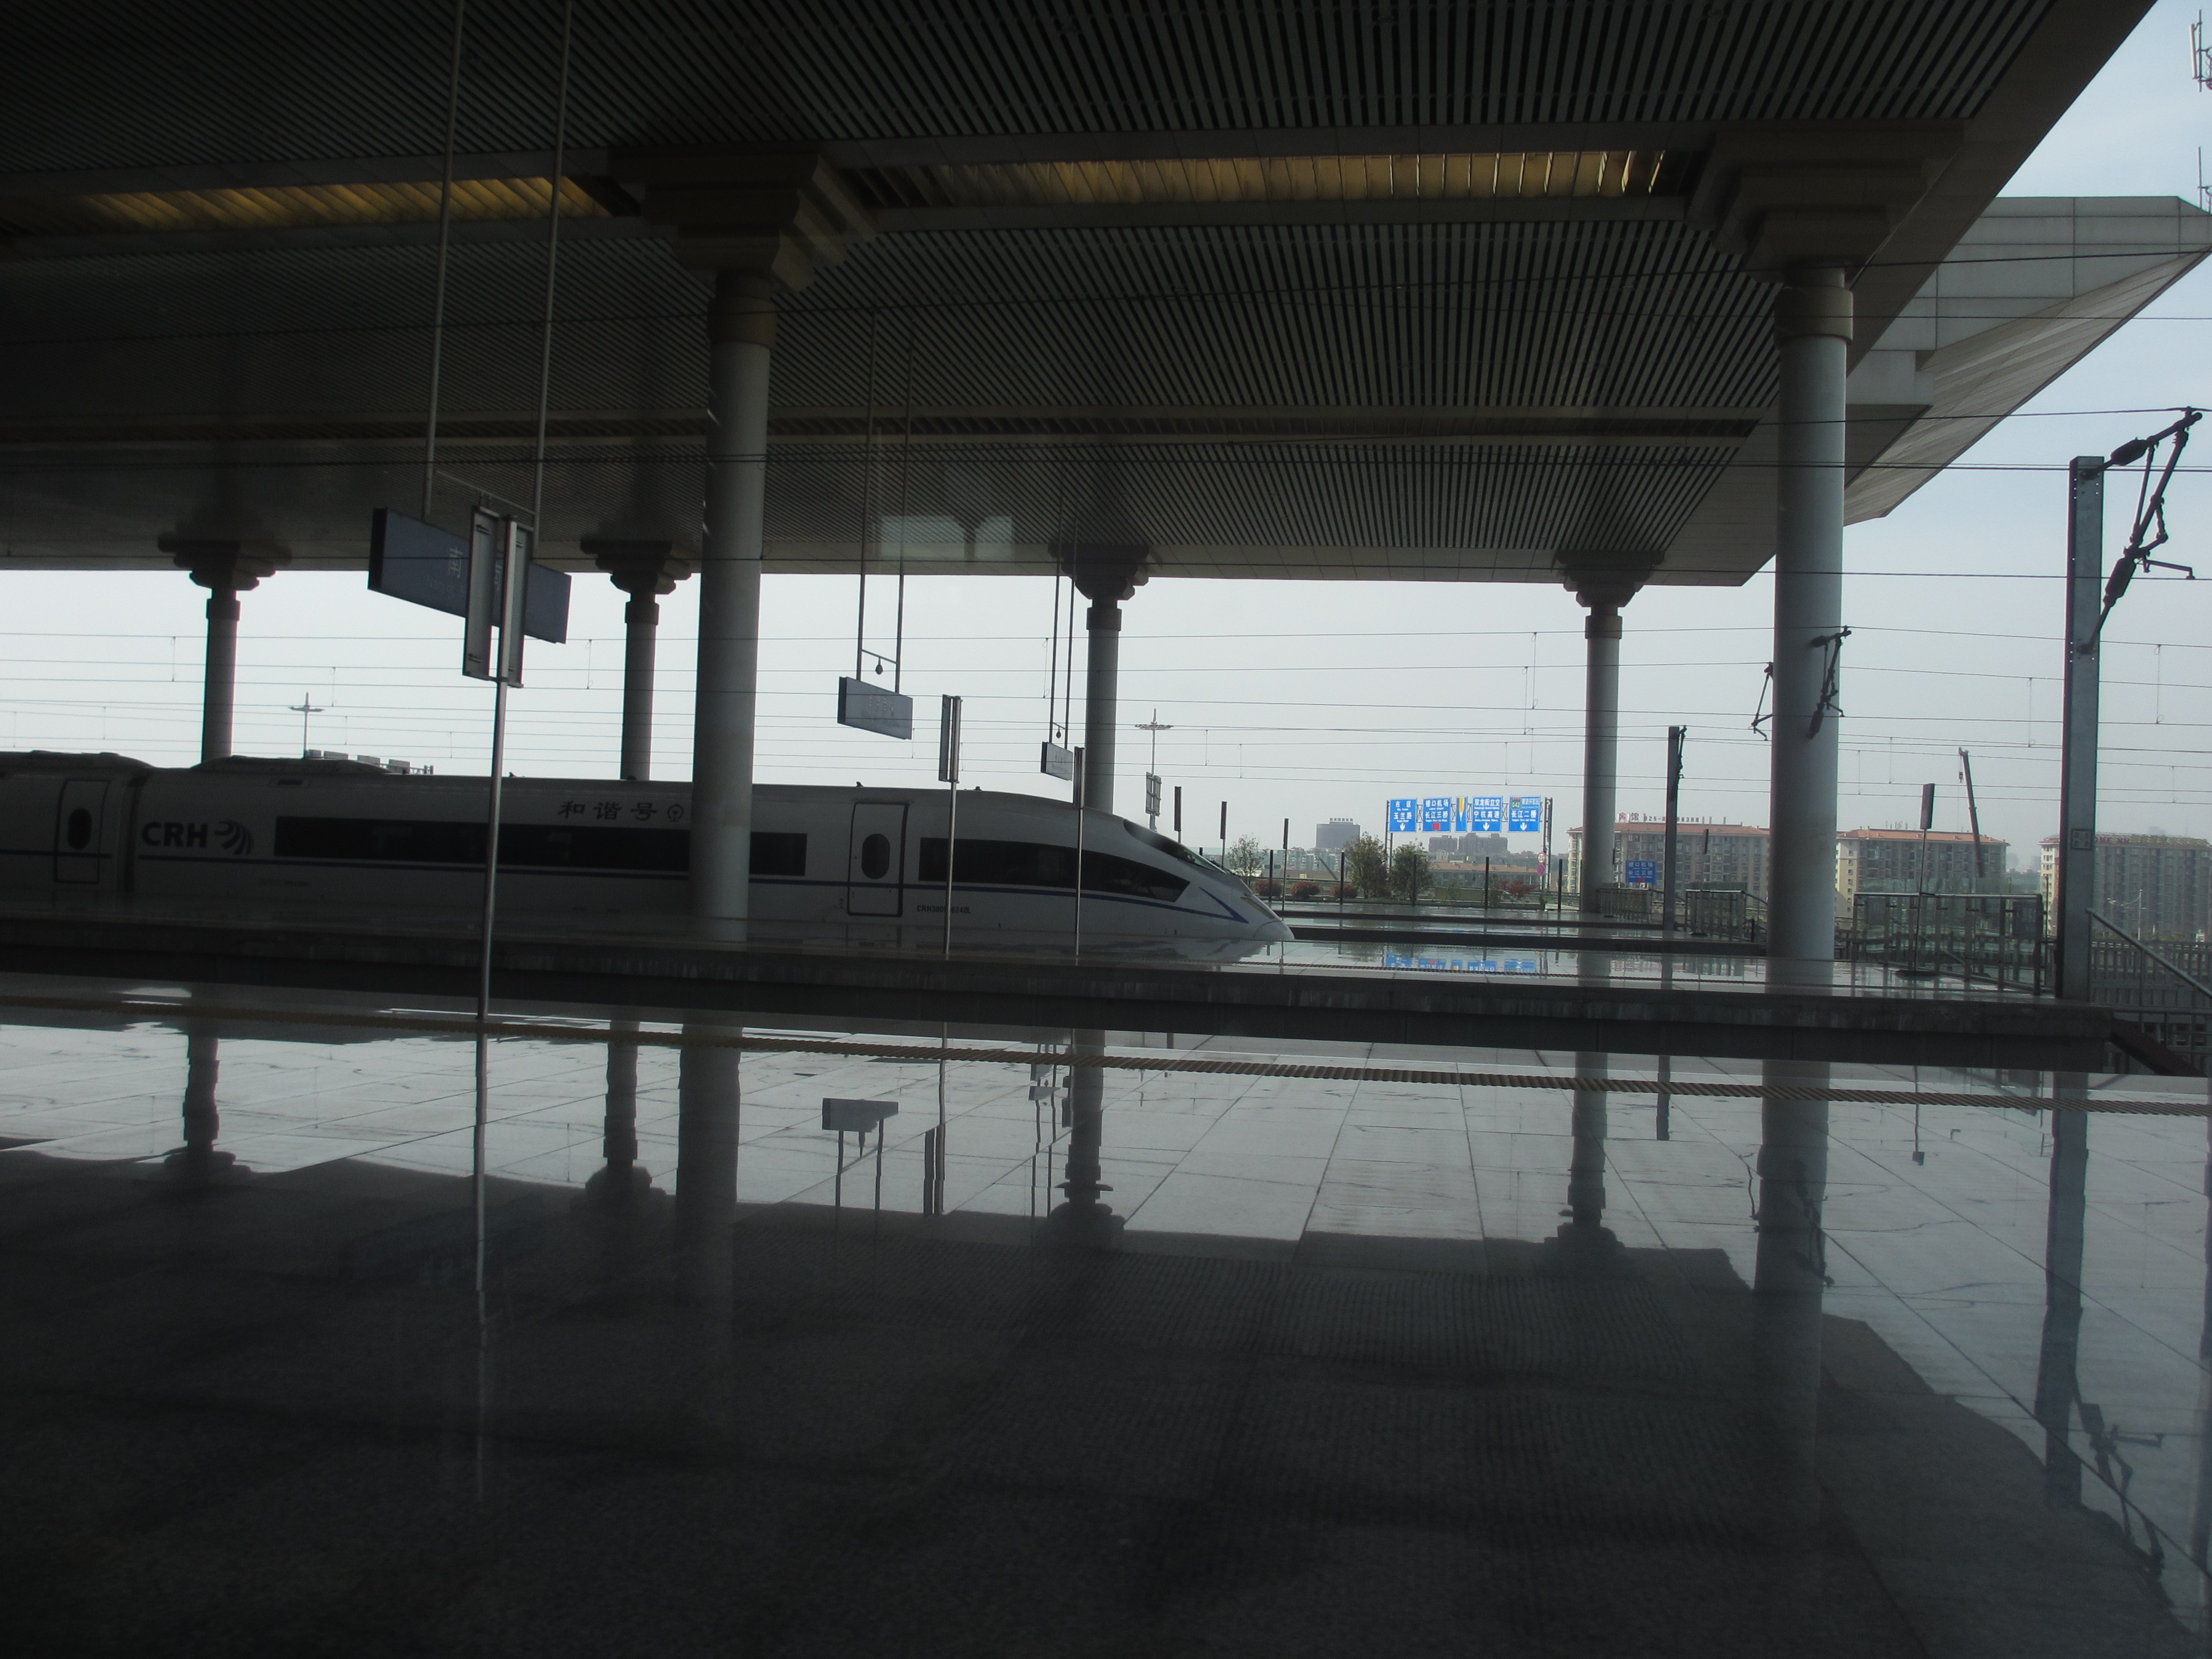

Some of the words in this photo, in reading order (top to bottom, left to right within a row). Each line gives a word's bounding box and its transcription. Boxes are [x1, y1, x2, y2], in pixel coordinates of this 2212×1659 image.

[558, 800, 658, 821] 和谐号
[1511, 810, 1536, 818] 长江二桥
[142, 821, 208, 848] CRH
